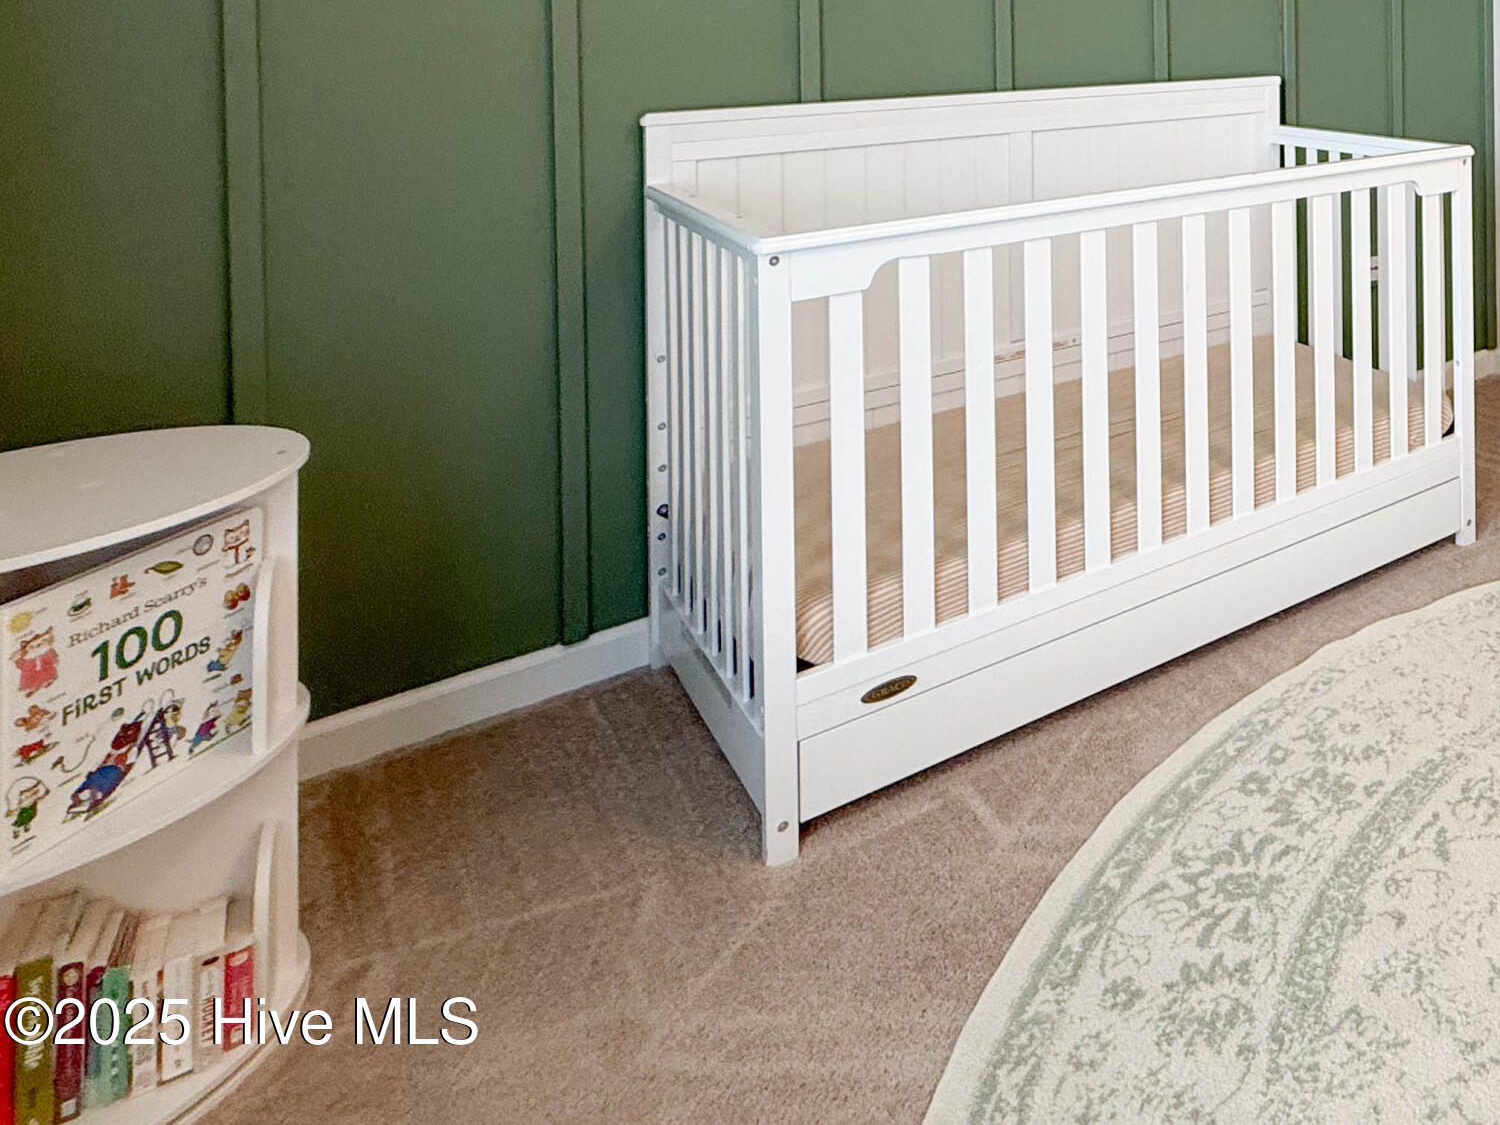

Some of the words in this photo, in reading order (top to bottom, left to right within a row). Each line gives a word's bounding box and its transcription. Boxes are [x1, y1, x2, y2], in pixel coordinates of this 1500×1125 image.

[67, 609, 140, 649] Richard
[144, 577, 208, 612] Scarry's
[91, 609, 184, 683] 100
[135, 636, 212, 687] WORDS
